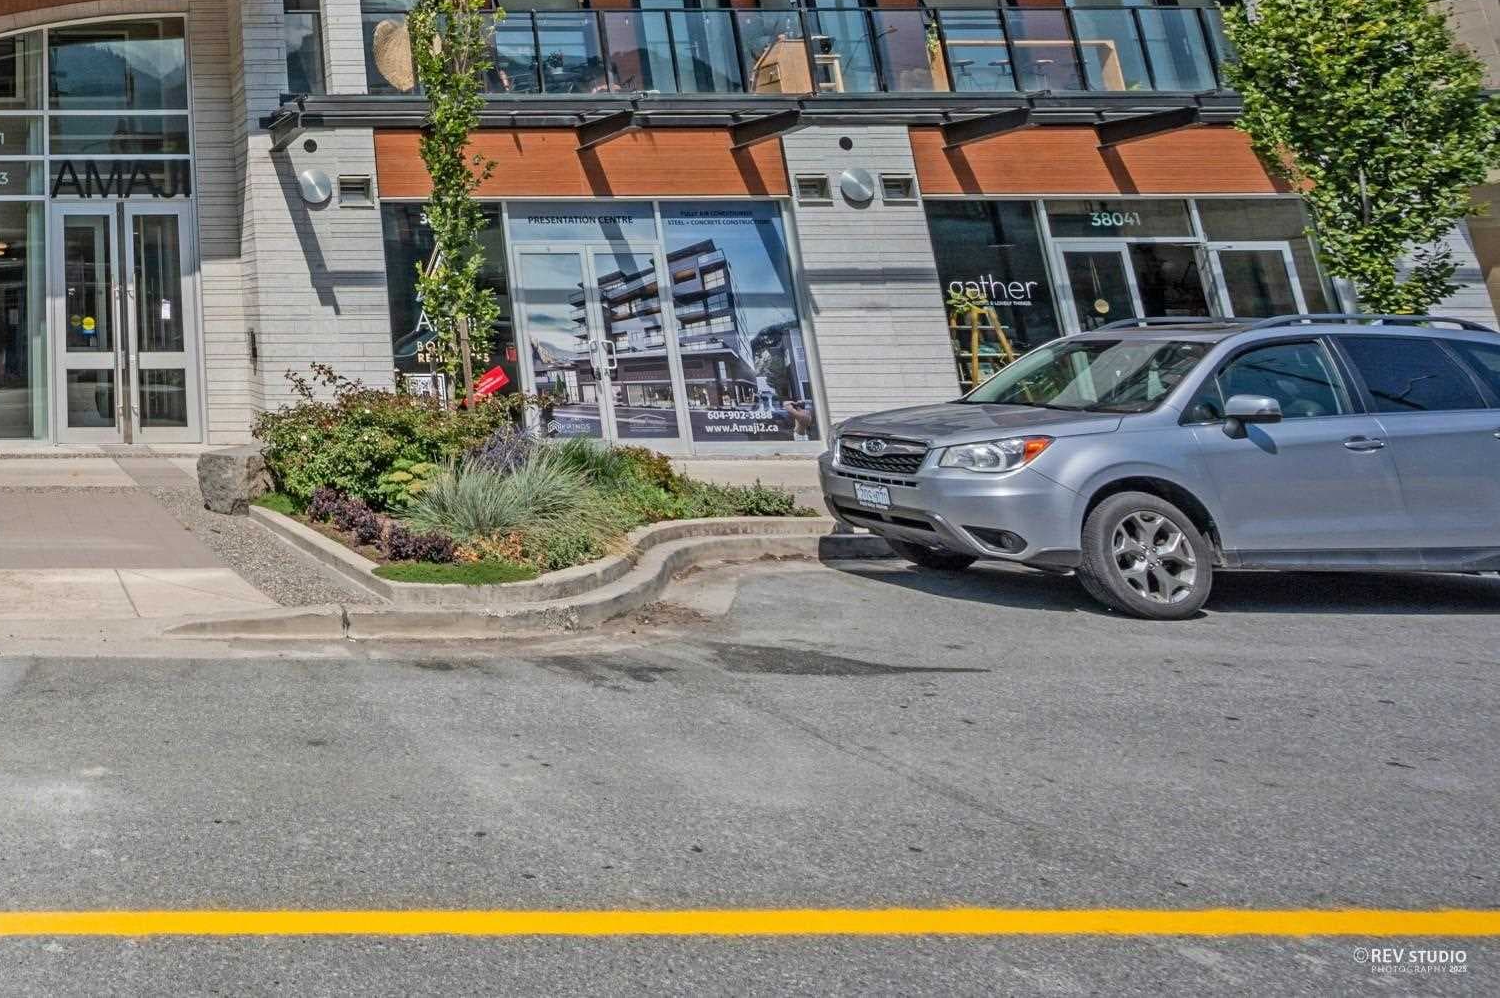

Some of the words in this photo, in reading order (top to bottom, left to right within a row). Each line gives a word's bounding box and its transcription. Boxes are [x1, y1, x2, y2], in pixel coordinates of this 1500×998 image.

[50, 159, 191, 199] AMAJI
[527, 215, 596, 224] PRESENTATION
[598, 215, 634, 224] CENTRE
[1090, 212, 1141, 227] 38041
[949, 273, 1038, 304] gather
[707, 410, 773, 420] 604-902-3888
[705, 423, 779, 434] www.Amaji2.ca
